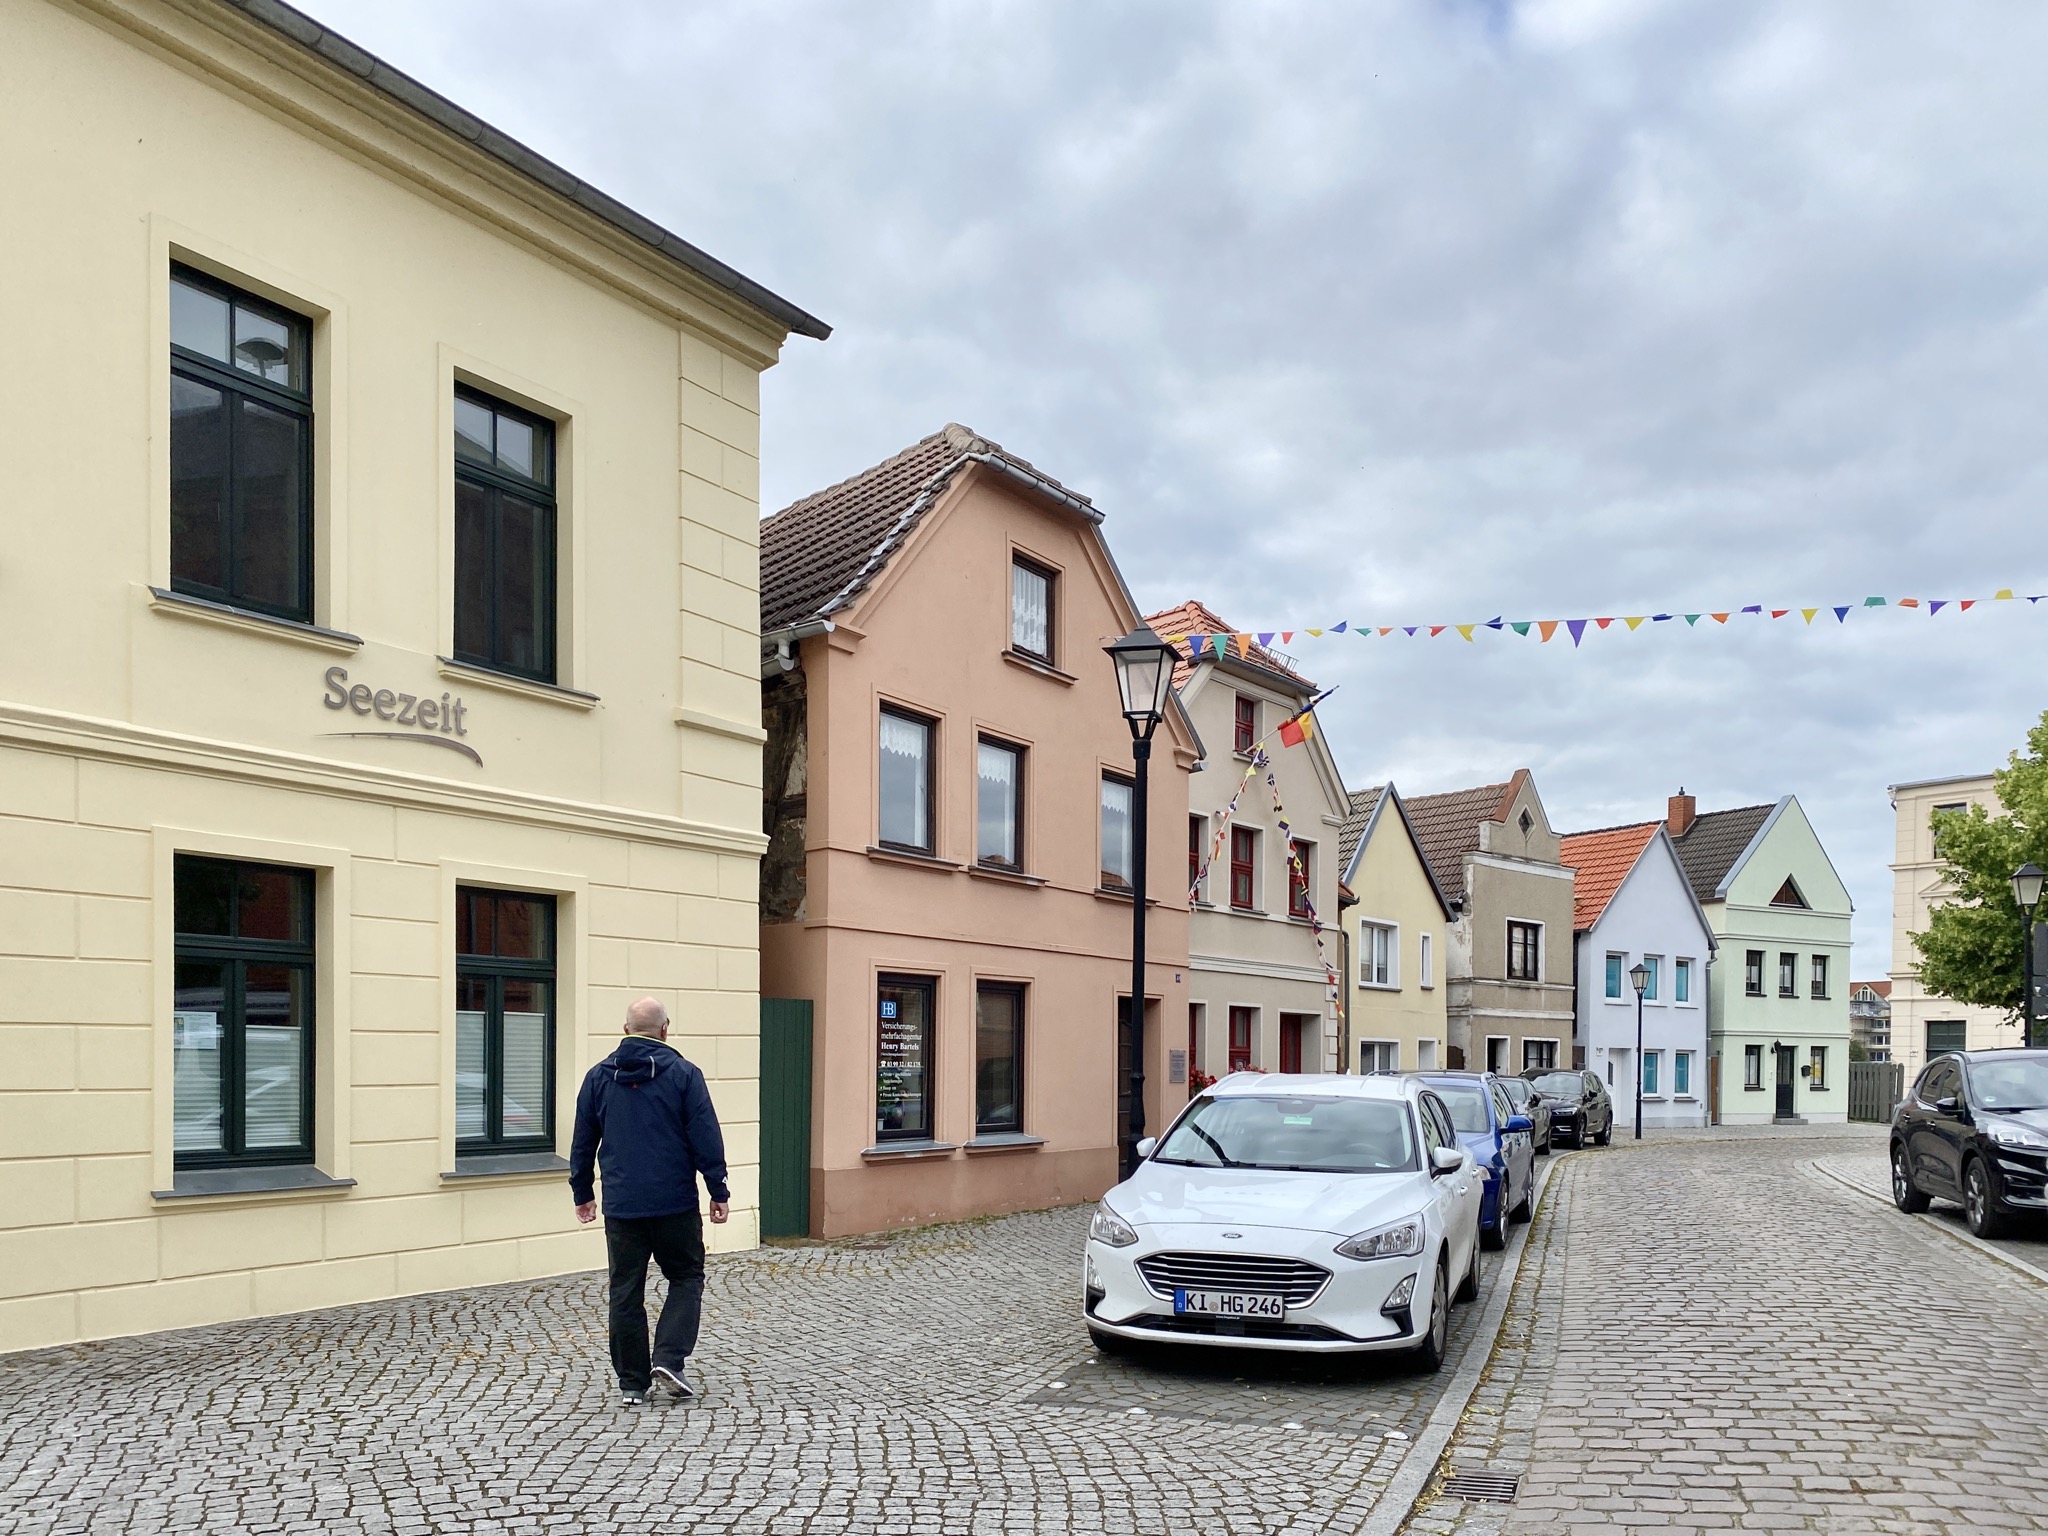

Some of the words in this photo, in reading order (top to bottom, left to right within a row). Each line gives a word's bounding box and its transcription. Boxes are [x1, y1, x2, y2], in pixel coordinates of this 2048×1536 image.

[324, 666, 468, 736] Seezeit
[883, 1002, 894, 1016] HB
[881, 1041, 898, 1051] Henry
[899, 1042, 919, 1050] Bartels
[1186, 1293, 1208, 1310] KI
[1220, 1295, 1244, 1313] HG
[1247, 1296, 1281, 1315] 246
